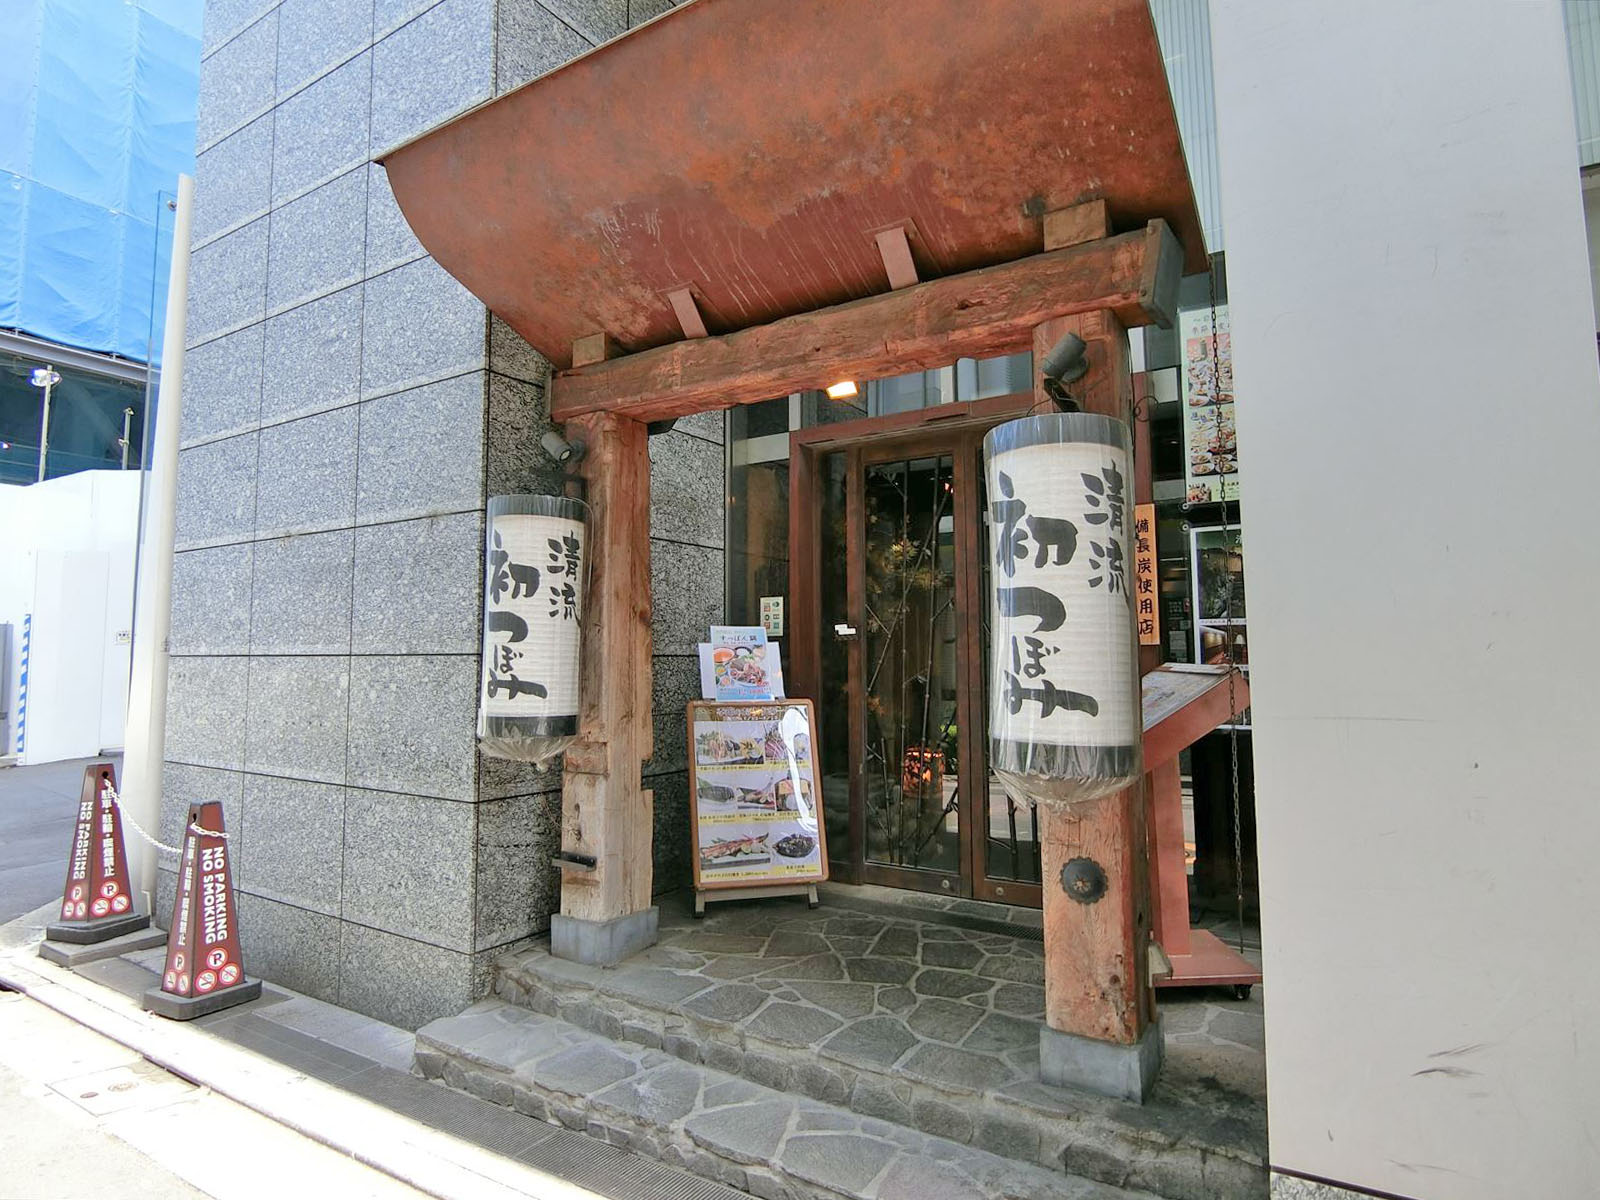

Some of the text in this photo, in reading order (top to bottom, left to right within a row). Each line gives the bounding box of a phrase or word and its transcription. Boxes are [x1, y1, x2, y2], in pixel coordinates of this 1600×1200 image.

[546, 529, 582, 629] 清流
[1080, 458, 1131, 611] 清流
[1136, 518, 1155, 636] 備長炭使用店
[992, 469, 1099, 719] 初つぼみ
[73, 802, 88, 880] NO SMOKING
[79, 802, 93, 879] NO PARKING
[202, 849, 217, 945] NO SMOKING
[213, 846, 228, 941] NO PARKING
